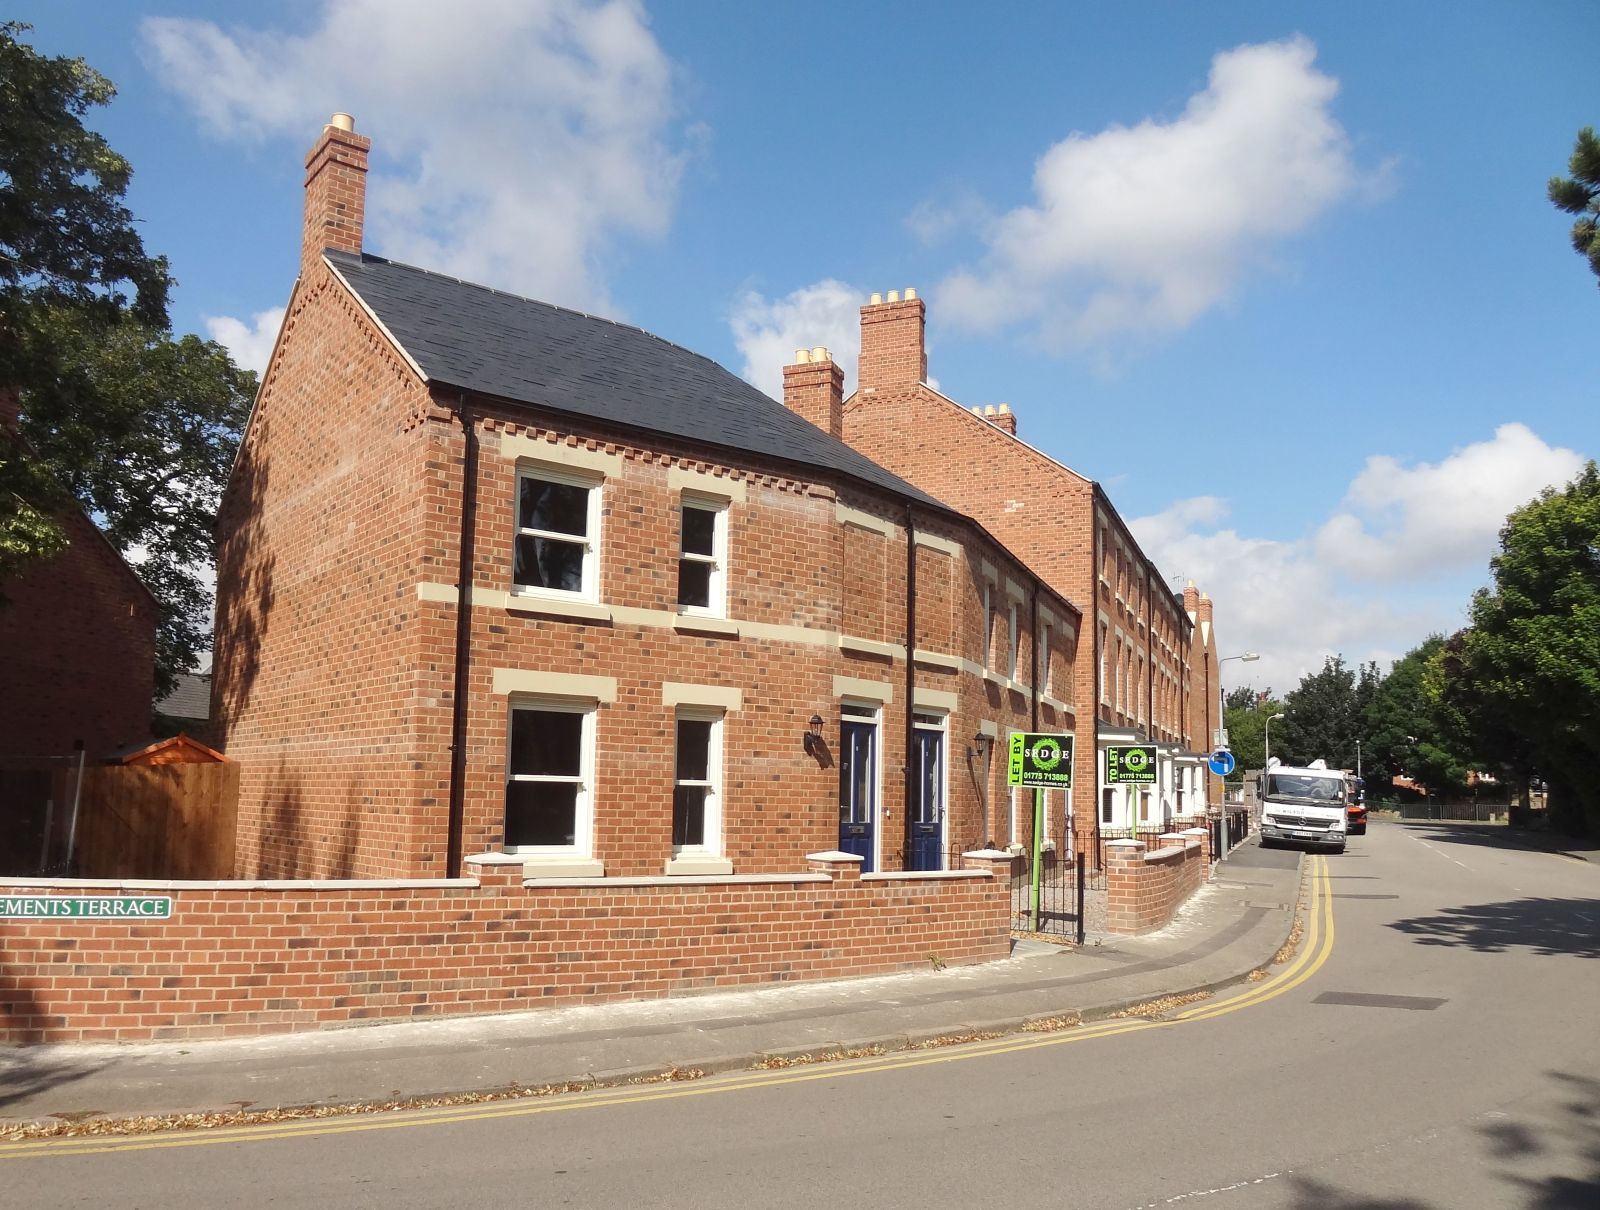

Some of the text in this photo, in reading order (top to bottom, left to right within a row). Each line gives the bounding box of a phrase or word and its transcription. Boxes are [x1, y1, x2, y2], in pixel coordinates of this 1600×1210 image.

[1012, 737, 1021, 783] LET BY
[1024, 748, 1069, 759] SEDGE
[1109, 749, 1117, 781] TO LET
[1023, 772, 1042, 780] 01775
[76, 900, 164, 915] TERRACE
